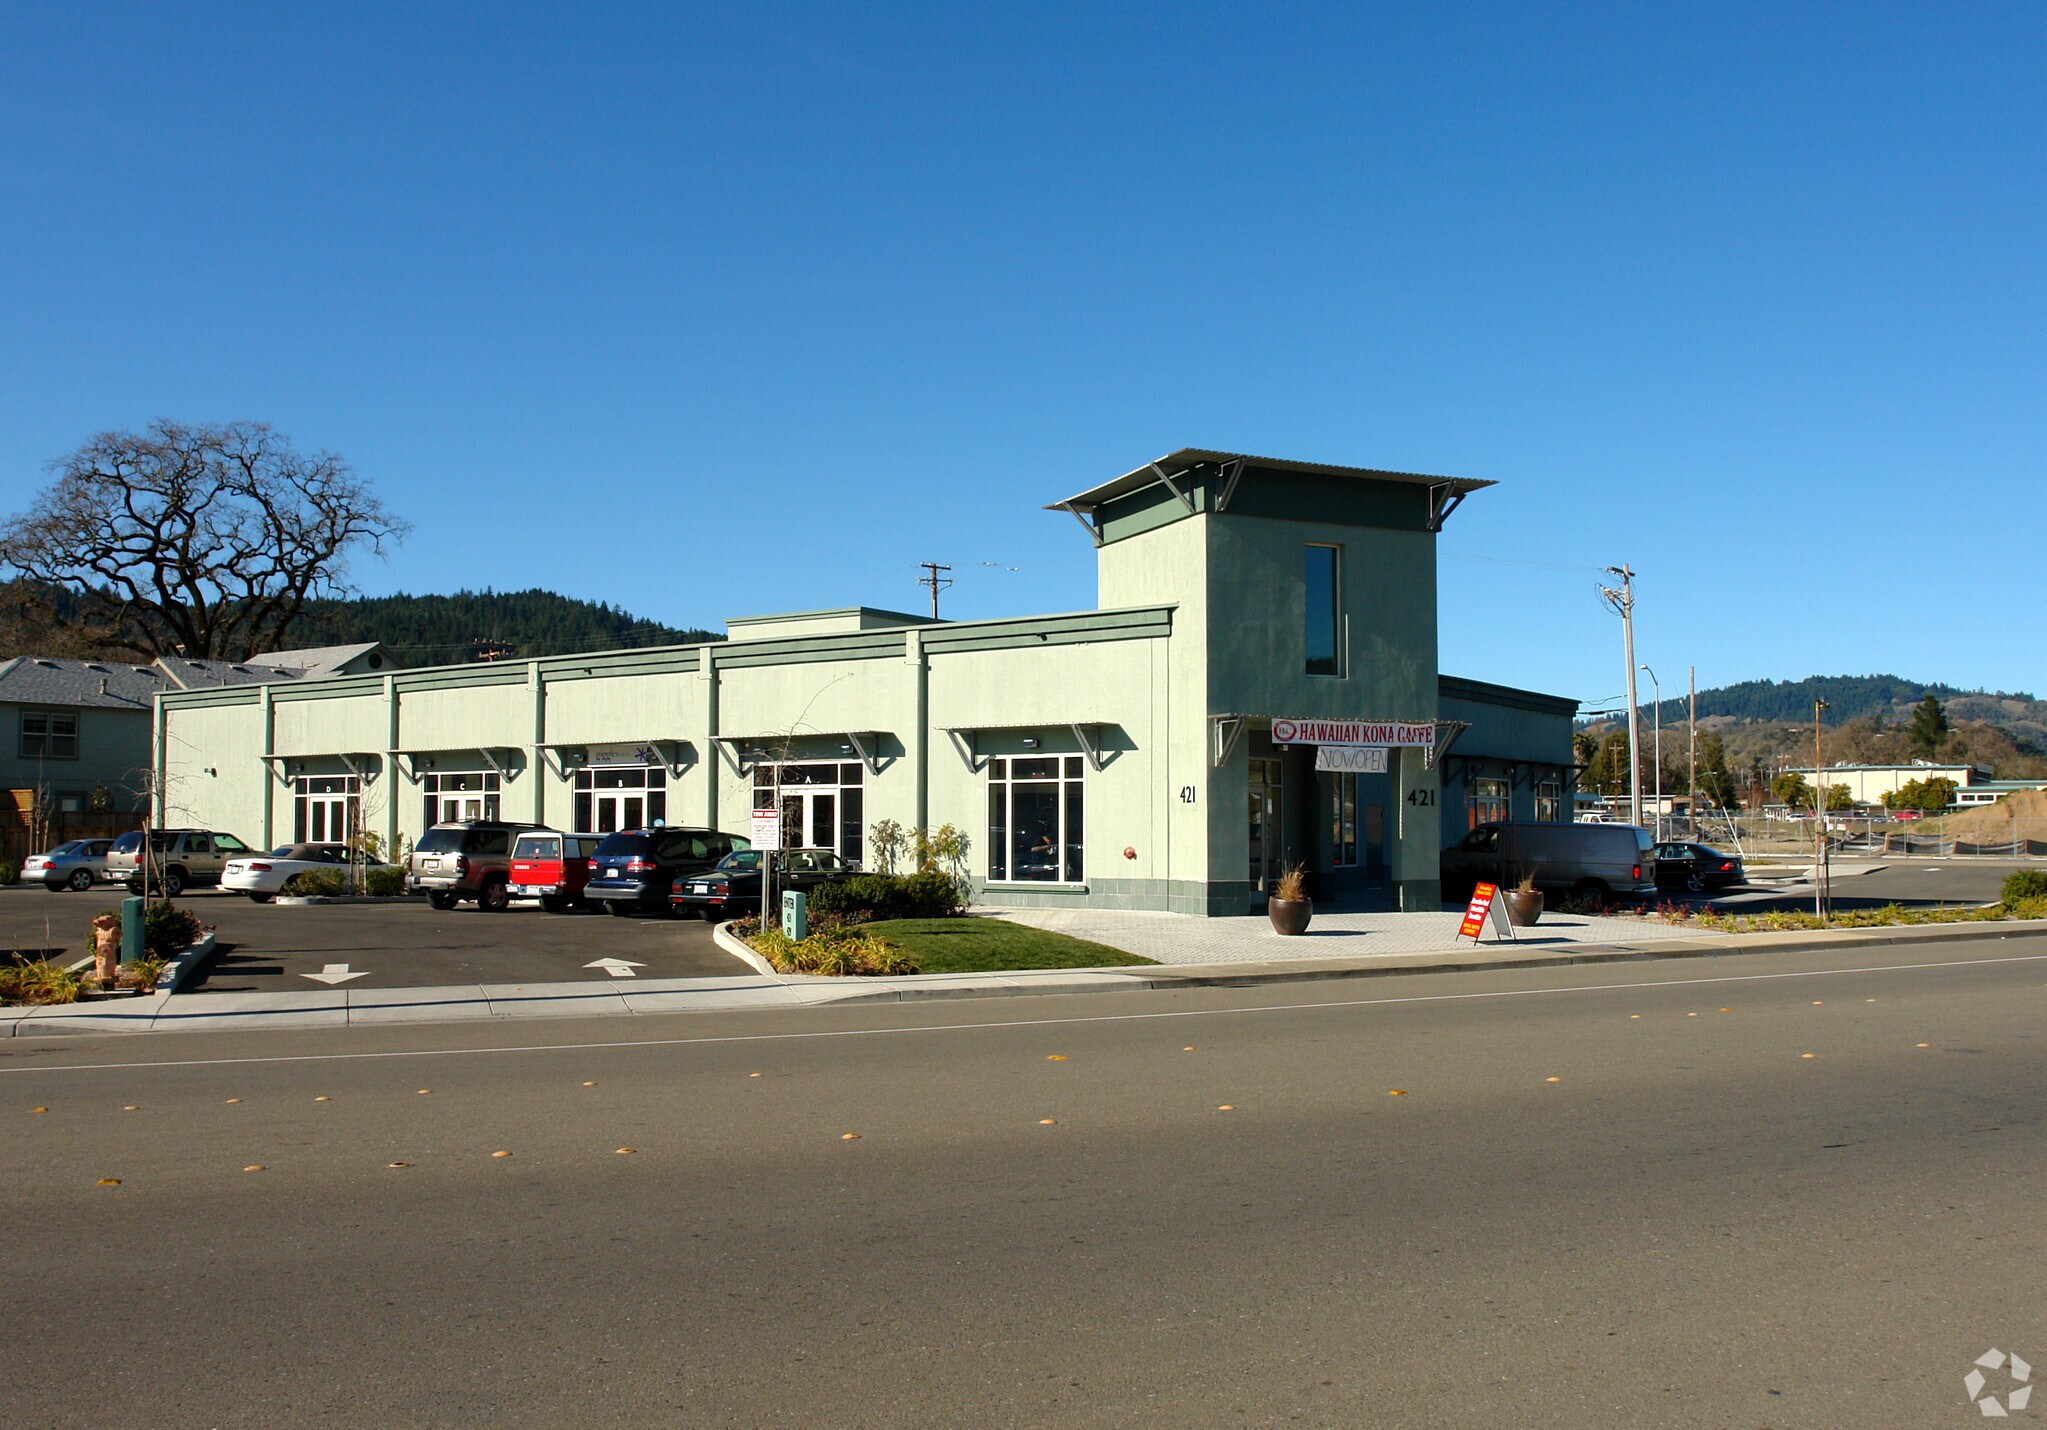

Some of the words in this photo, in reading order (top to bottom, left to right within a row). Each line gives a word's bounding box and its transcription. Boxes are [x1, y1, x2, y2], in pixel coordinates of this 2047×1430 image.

[1300, 723, 1360, 742] HAWAIIAN
[1363, 725, 1394, 743] KONA
[1319, 749, 1356, 769] NOW
[1356, 749, 1387, 771] OPEN
[618, 779, 624, 788] B
[805, 775, 812, 784] A
[326, 785, 332, 793] D
[460, 782, 465, 791] C
[1180, 785, 1196, 803] 421
[1407, 789, 1435, 806] 421
